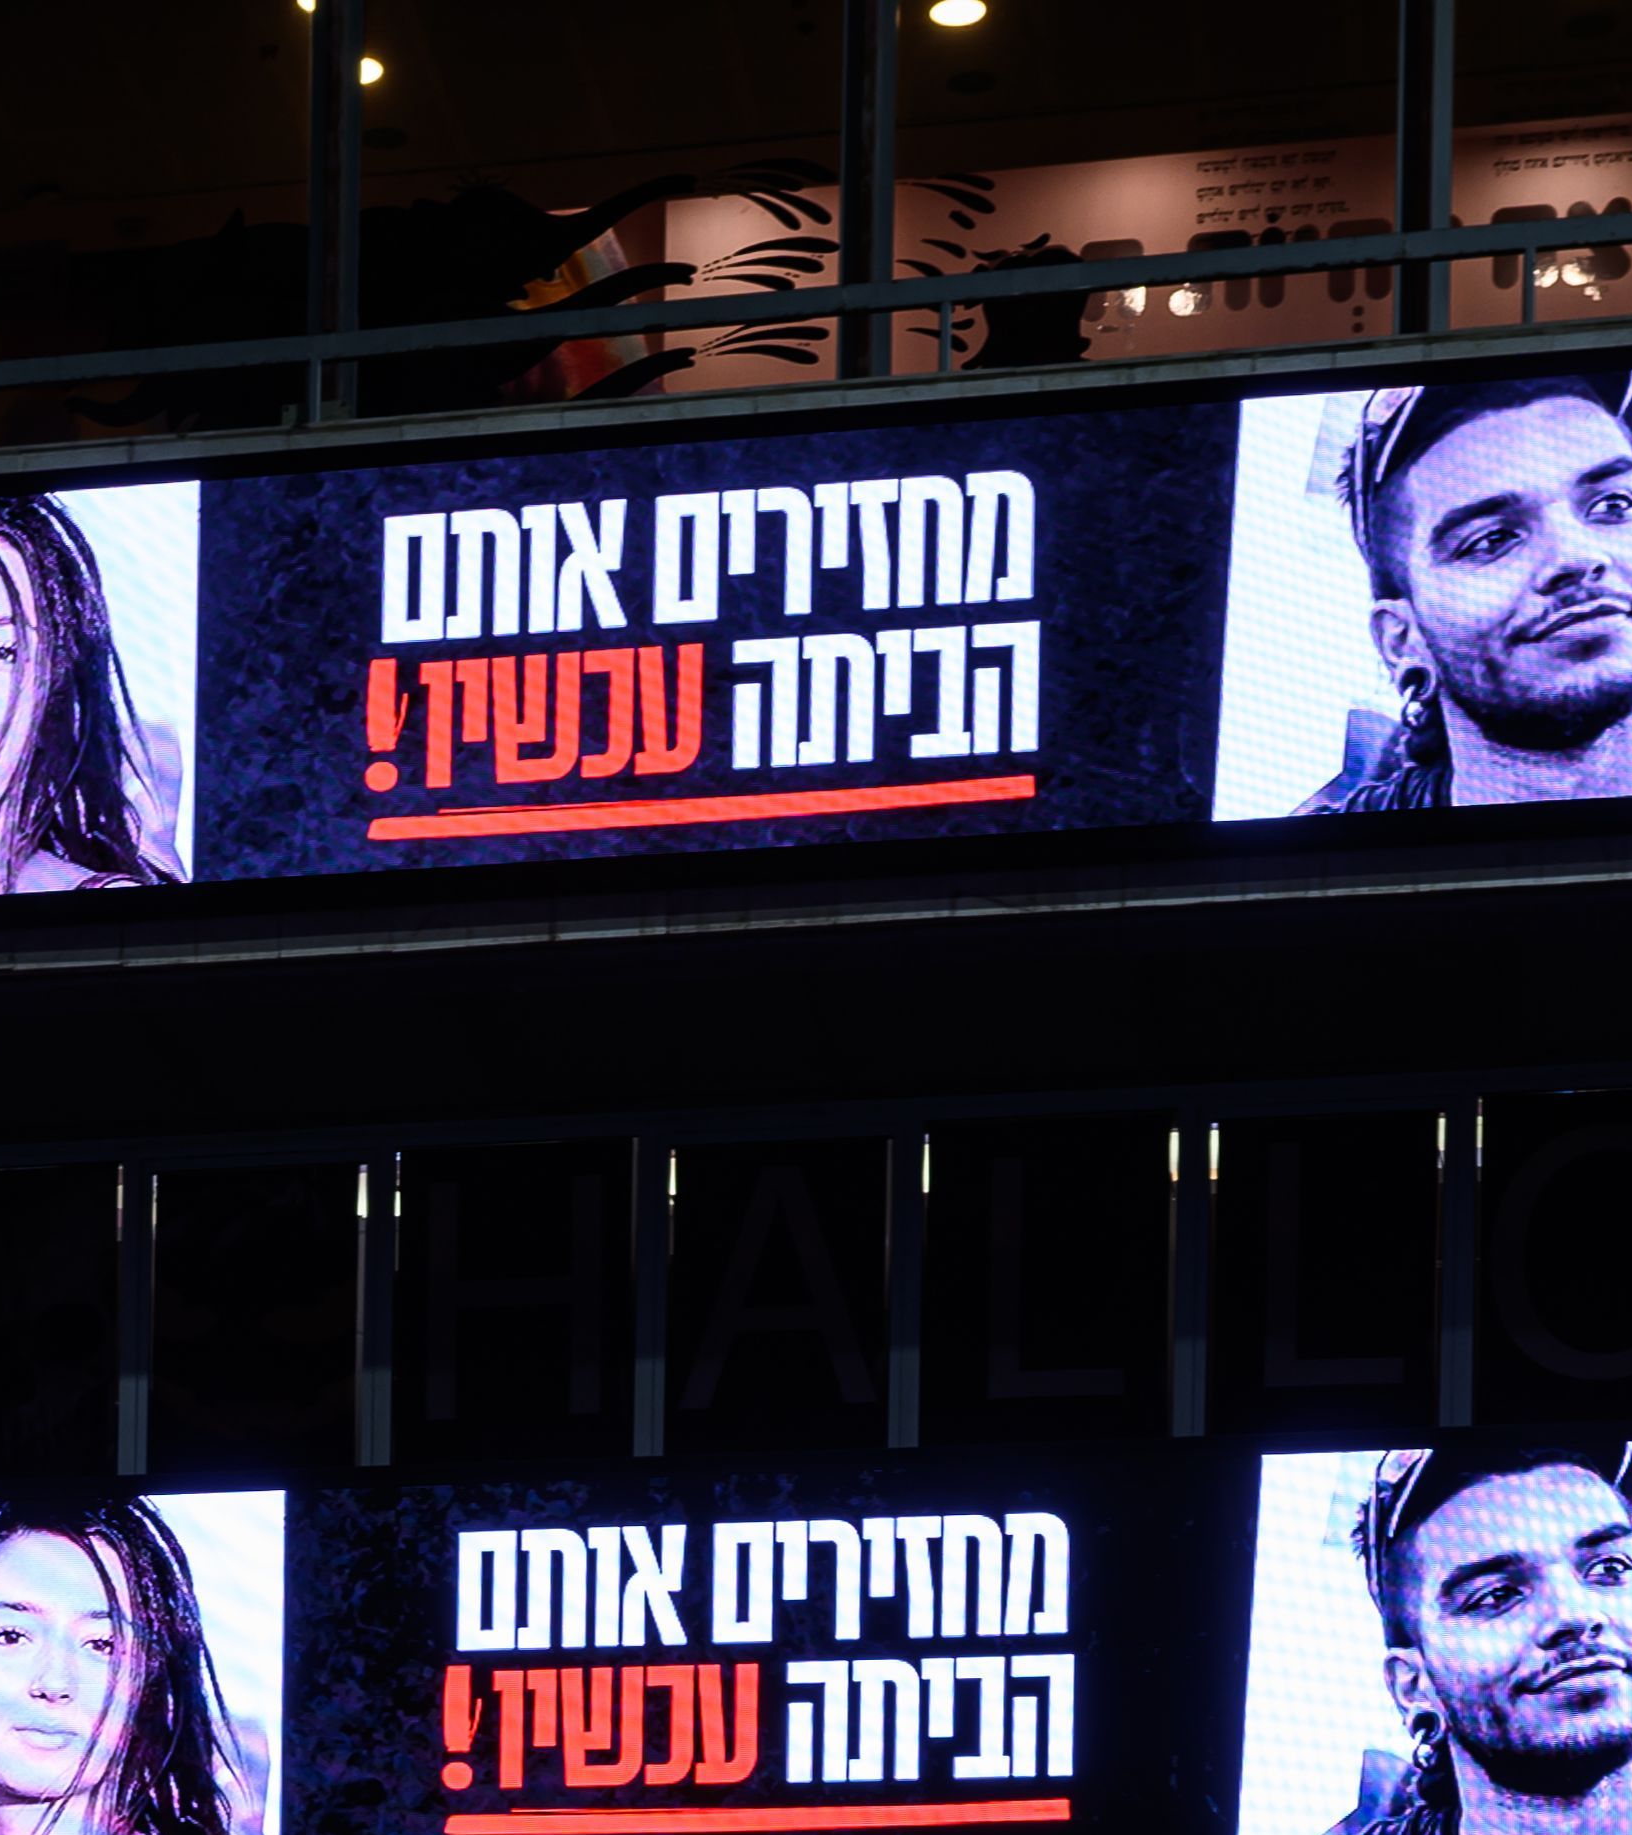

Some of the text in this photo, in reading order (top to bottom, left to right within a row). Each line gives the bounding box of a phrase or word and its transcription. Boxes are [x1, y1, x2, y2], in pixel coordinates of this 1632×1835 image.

[381, 470, 1035, 643] מחזירים אותם
[365, 620, 1040, 792] הביתה עכשיו!
[456, 1512, 1071, 1651] מחזירים אותם
[440, 1654, 1075, 1791] הביתה עכשיו!
